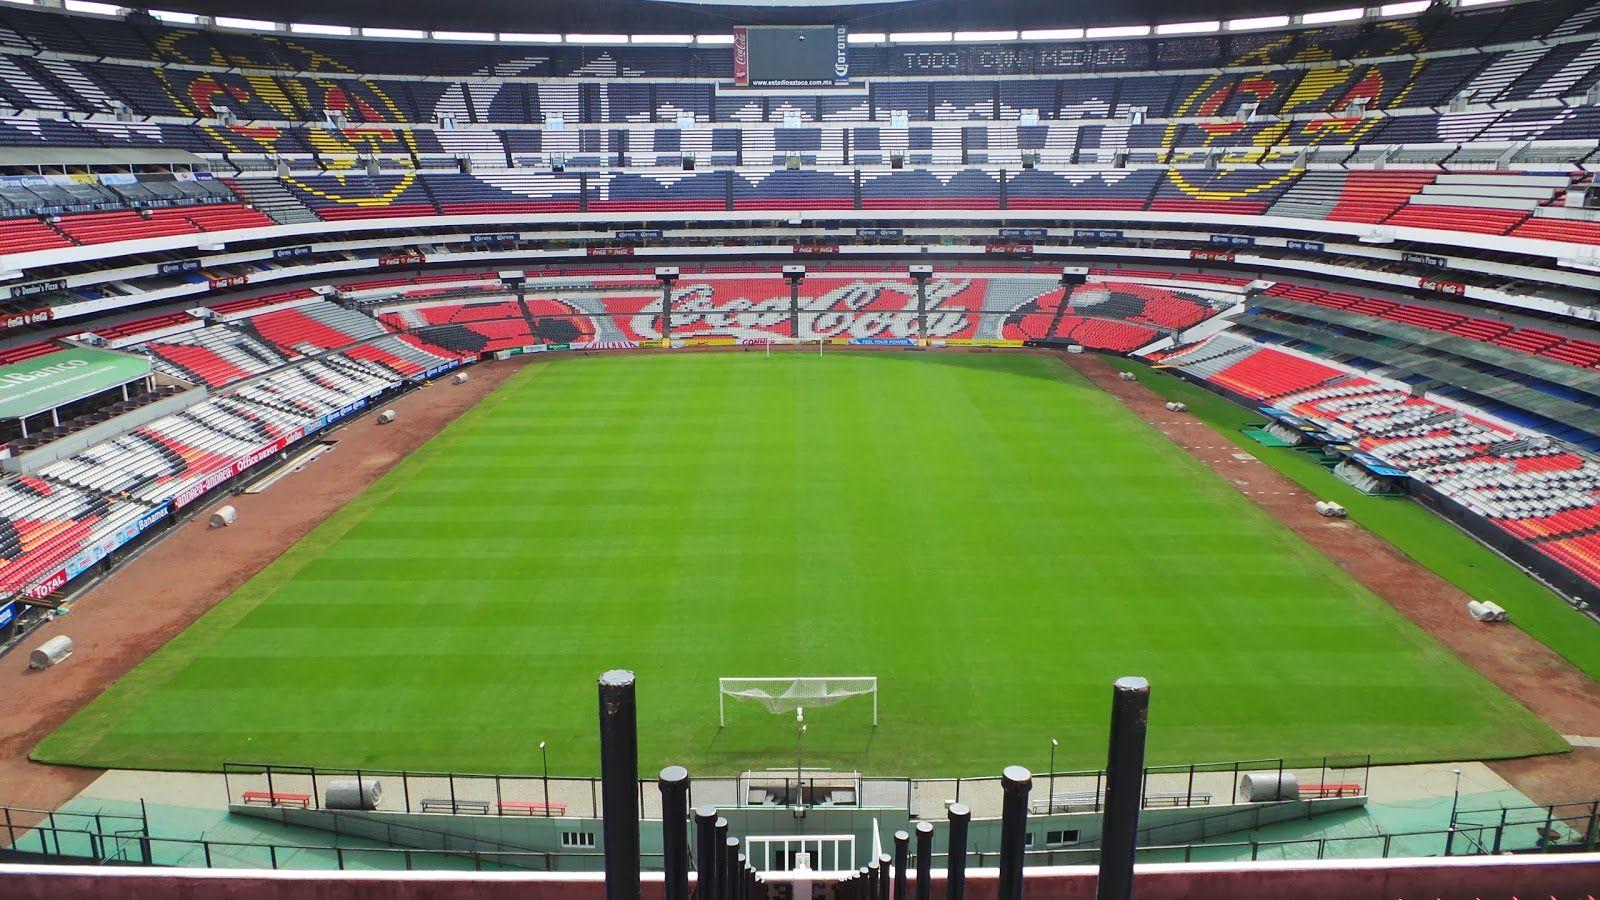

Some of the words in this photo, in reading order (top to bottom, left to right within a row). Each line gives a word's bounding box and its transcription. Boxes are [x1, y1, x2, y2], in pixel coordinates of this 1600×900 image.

[835, 28, 849, 77] Corona
[903, 52, 959, 68] TODO
[1041, 48, 1127, 67] MEDIDA
[752, 79, 833, 87] www.estadioazteca.com.mx
[237, 453, 260, 471] Office
[258, 445, 278, 461] DEPOT
[138, 506, 169, 531] Banamex
[34, 576, 64, 598] TOTAL
